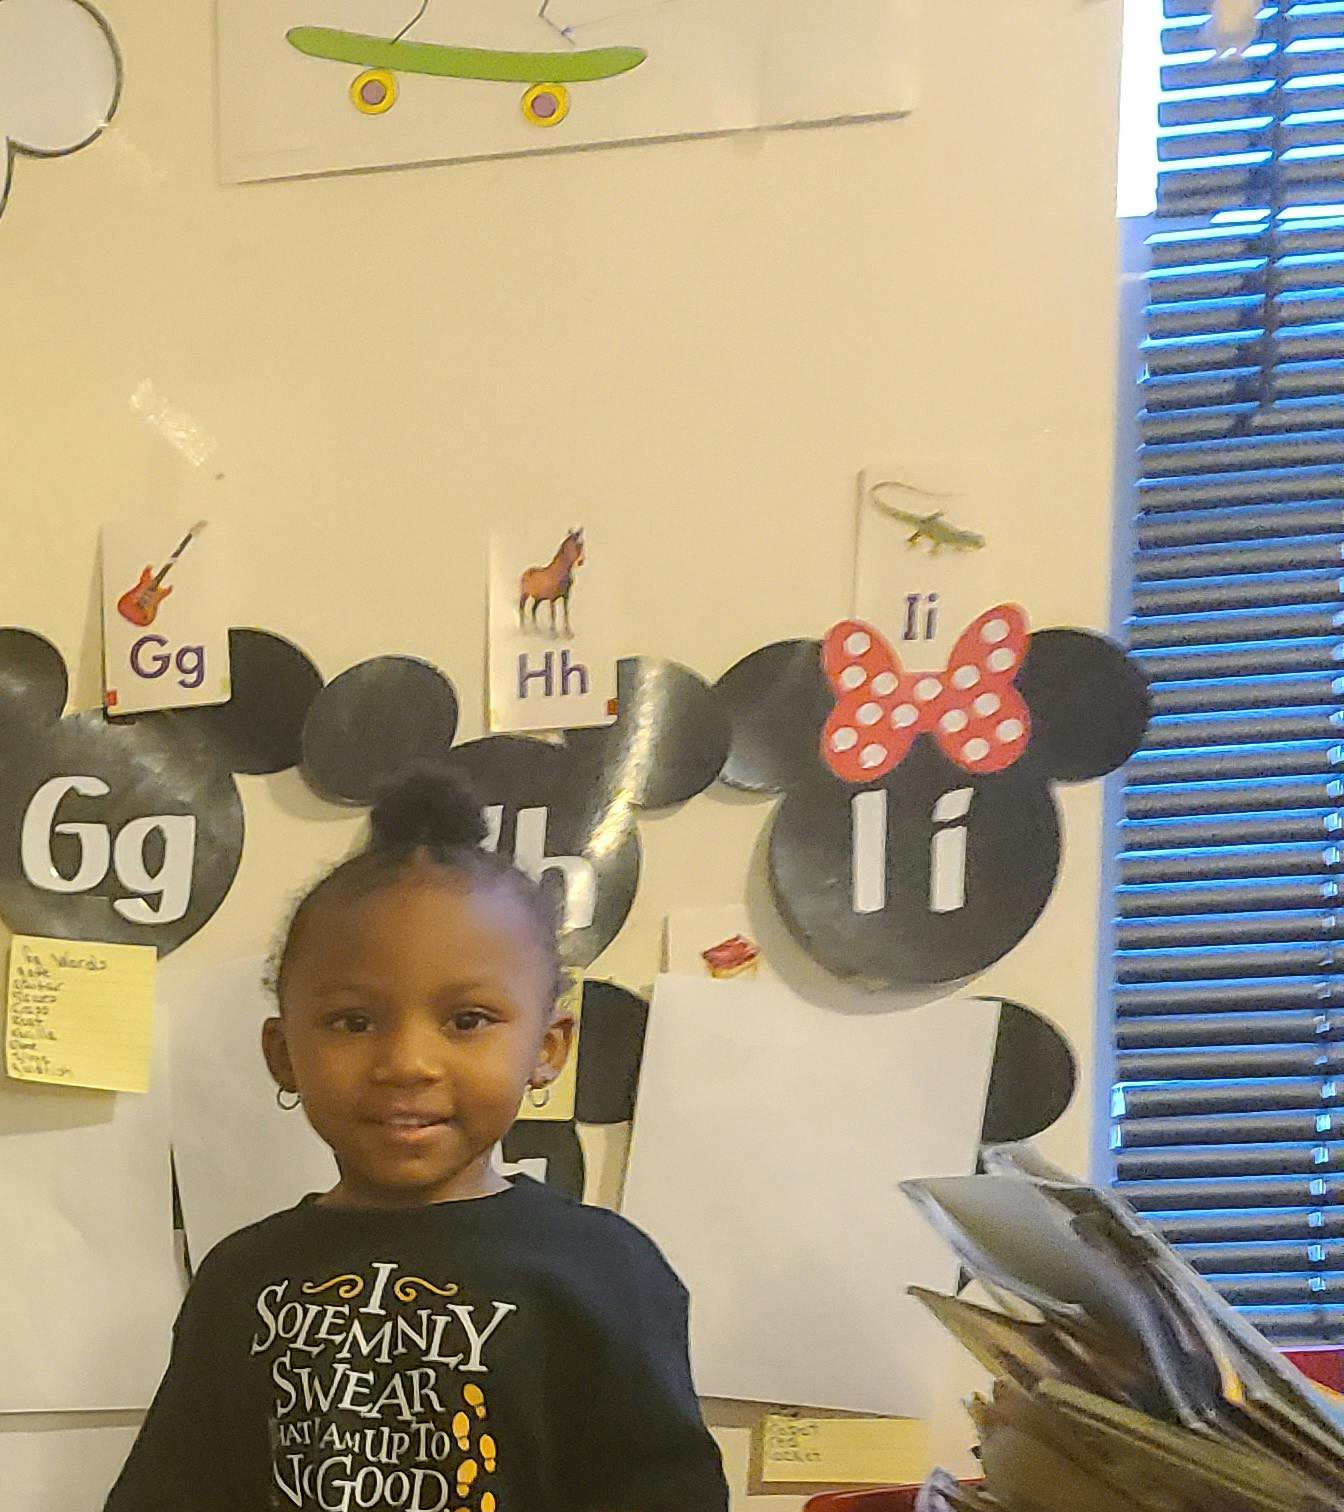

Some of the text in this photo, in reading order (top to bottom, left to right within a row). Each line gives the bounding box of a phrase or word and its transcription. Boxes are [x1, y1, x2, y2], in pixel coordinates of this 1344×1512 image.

[129, 635, 206, 688] Gg
[517, 651, 590, 698] Hh
[21, 775, 197, 925] Gg
[481, 805, 597, 929] h
[359, 1262, 399, 1316] I
[250, 1279, 518, 1373] SOLEMNLY
[273, 1350, 447, 1421] SWEAR
[364, 1427, 410, 1464] UP
[410, 1421, 451, 1462] TO
